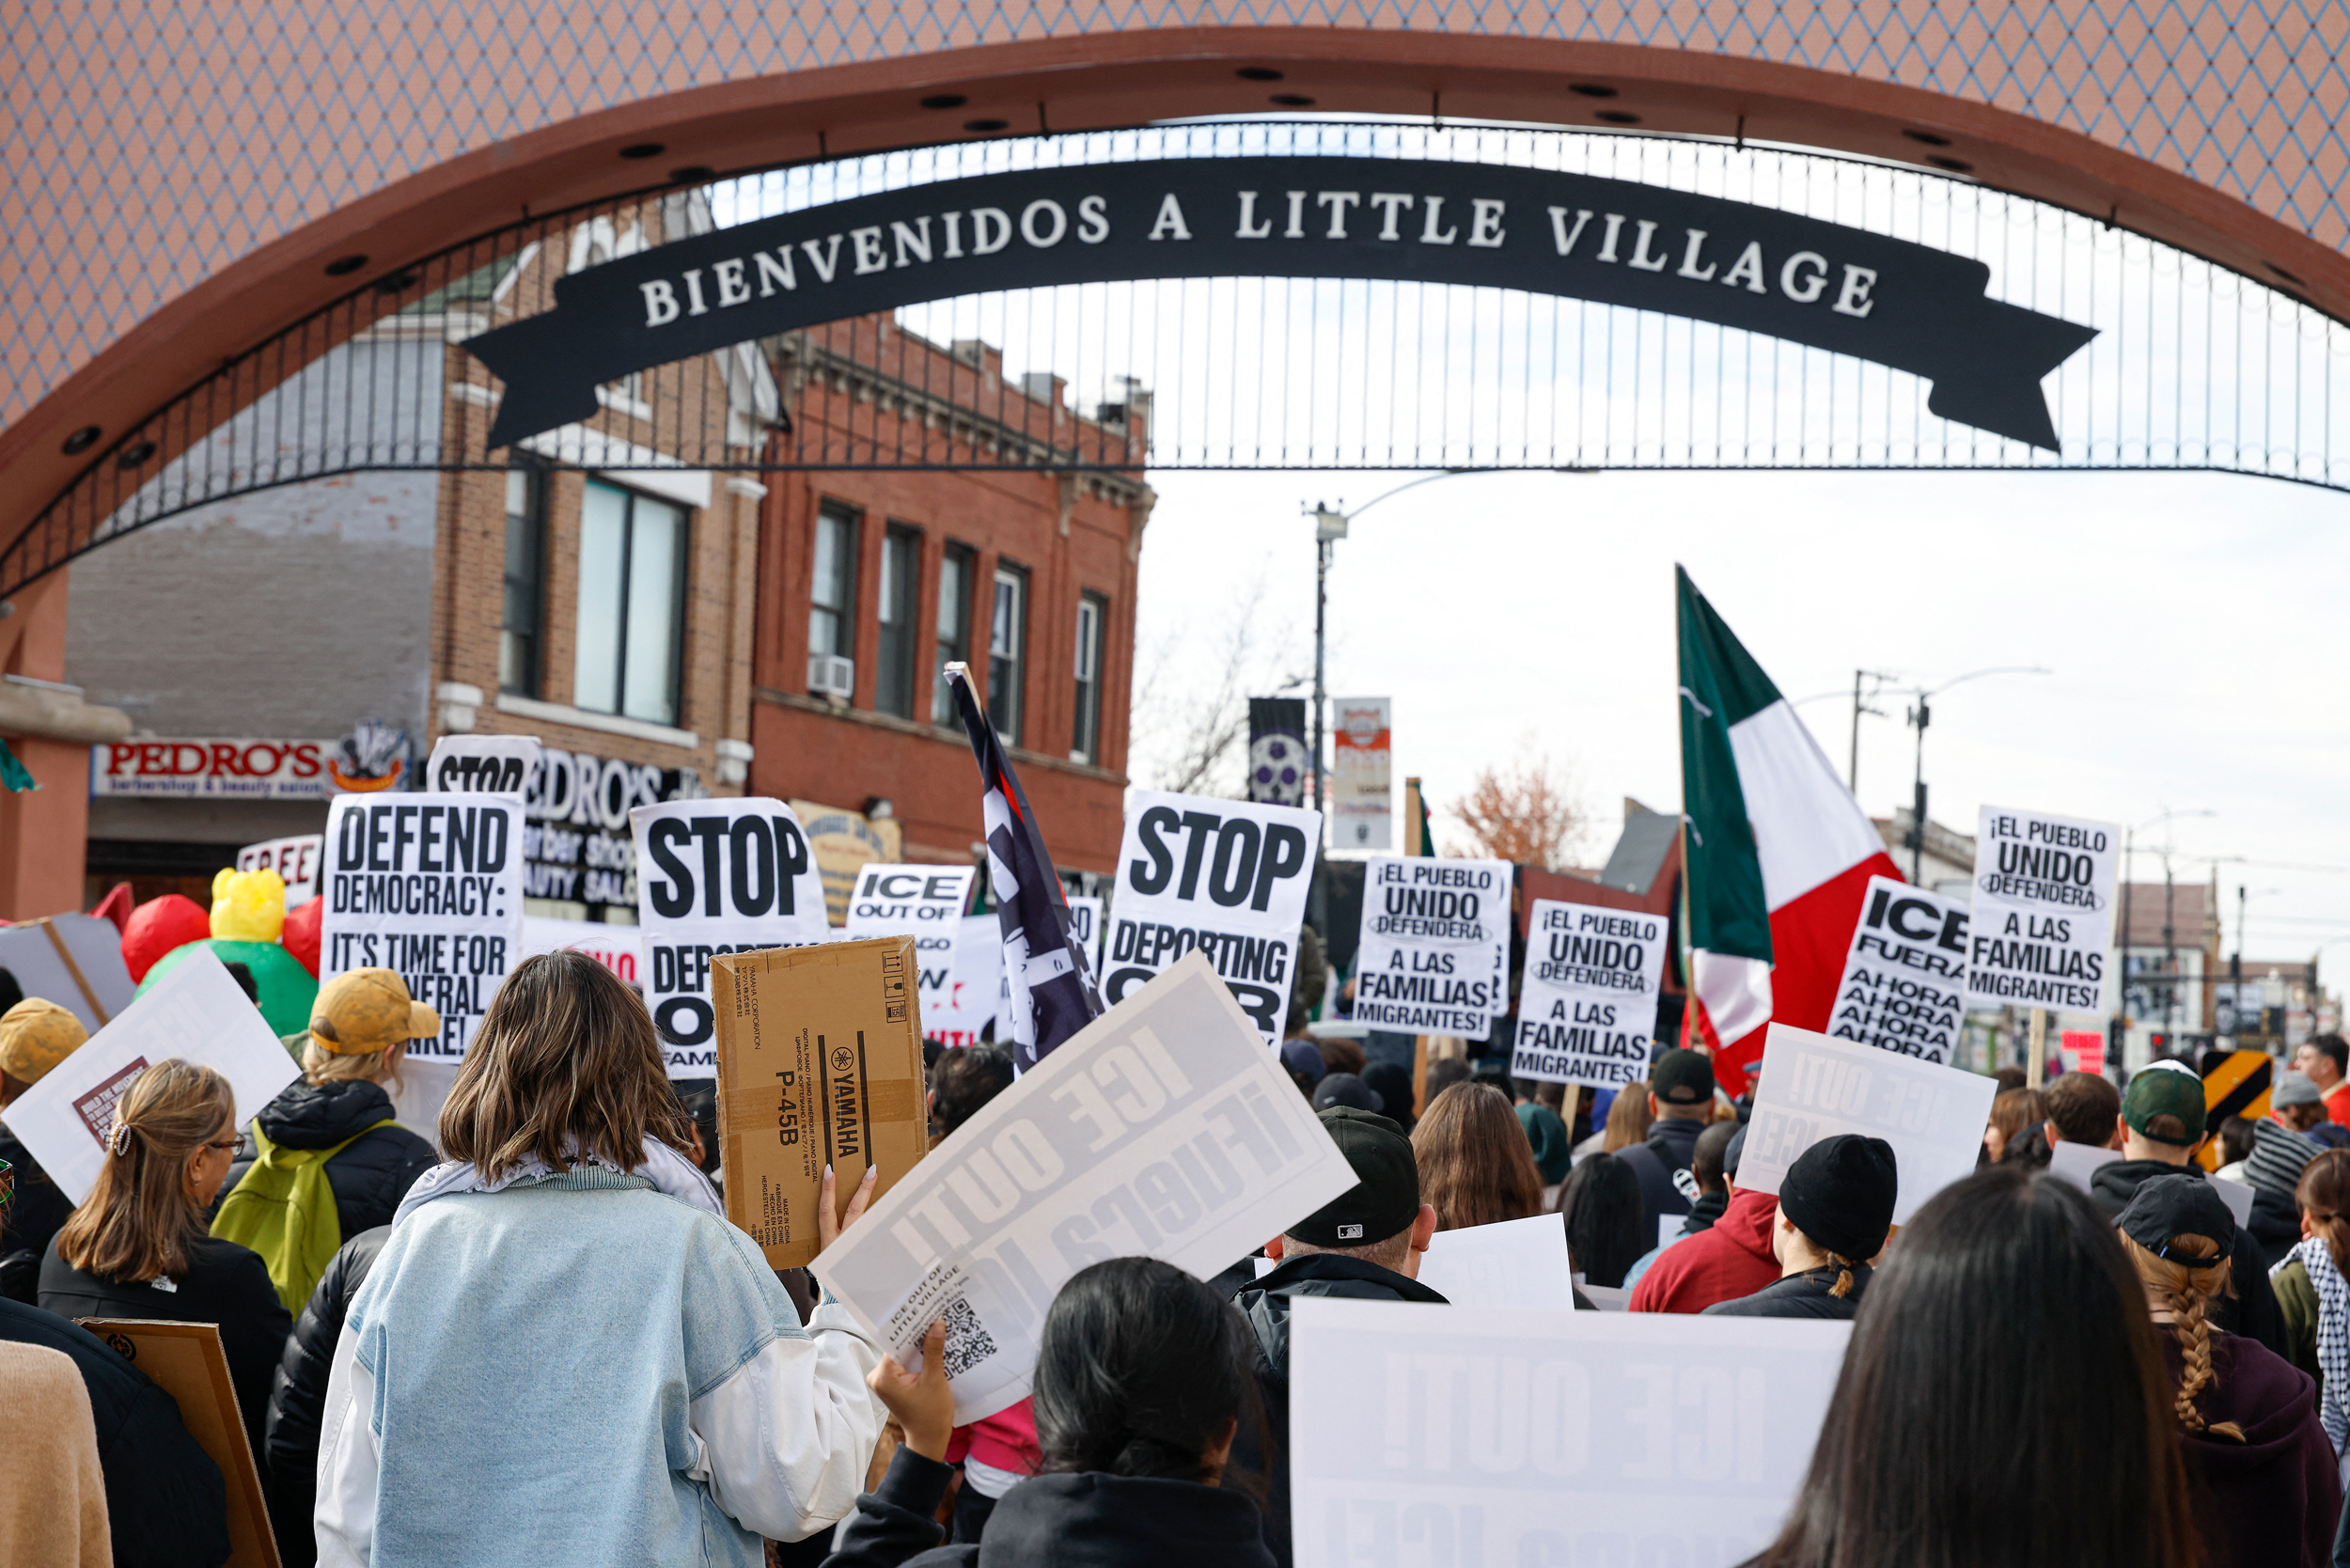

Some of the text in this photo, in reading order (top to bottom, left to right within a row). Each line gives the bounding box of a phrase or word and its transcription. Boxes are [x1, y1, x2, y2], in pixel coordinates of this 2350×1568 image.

[639, 191, 1878, 327] BIENVENIDOS A LITTLE VILLAGE
[106, 743, 321, 777] PEDRO'S
[110, 777, 196, 795] barbershop
[203, 777, 214, 792] &
[219, 778, 273, 796] beauty
[525, 747, 662, 830] EDRO'S
[338, 806, 508, 873] DEFEND
[1991, 816, 2106, 853] ¡EL PUEBLO
[648, 815, 807, 918] STOP
[1130, 806, 1307, 912] STOP
[1378, 865, 1492, 889] ¡EL PUEBLO
[1998, 841, 2093, 886] UNIDO
[333, 874, 506, 917] DEMOCRACY:
[583, 870, 637, 905] SALO
[862, 873, 963, 900] ICE
[1385, 886, 1480, 921] UNIDO
[1989, 873, 2096, 910] DEFENDERÁ
[856, 903, 955, 920] OUT OF
[1377, 916, 1482, 941] DEFENDERÁ
[1543, 910, 1657, 941] ¡EL PUEBLO
[1866, 888, 1969, 953] ICE
[2004, 912, 2071, 943] A LAS
[331, 933, 506, 975] IT'S TIME FOR
[1112, 919, 1288, 985] DEPORTING
[1389, 949, 1455, 974] A LAS
[1549, 933, 1644, 972] UNIDO
[1857, 934, 1966, 979] FUERA
[1971, 936, 2103, 981] FAMILIAS
[402, 975, 486, 1015] NERAL
[1359, 973, 1488, 1008] FAMILIAS
[1540, 962, 1645, 993] DEFENDERÁ
[1850, 968, 1962, 1012] AHORA
[1969, 971, 2098, 1009] MIGRANTES!
[749, 964, 761, 1050] YAMAHA CORPORATION
[1356, 1003, 1483, 1032] MIGRANTES!
[1550, 999, 1617, 1027] A LAS
[1844, 987, 1956, 1031] AHORA
[1519, 1022, 1646, 1060] FAMILIAS
[1834, 1025, 1942, 1065] AHORA
[1840, 1006, 1950, 1050] AHORA
[1515, 1052, 1642, 1083] MIGRANTES!
[99, 1088, 115, 1102] THE
[776, 1070, 799, 1147] P-45B
[802, 1028, 810, 1053] DIGITAL
[810, 1160, 819, 1184] DIGITAL
[834, 1073, 858, 1158] YAMAHA
[761, 1175, 770, 1218] HERGESTELLT
[771, 1216, 776, 1226] EN
[777, 1215, 784, 1225] EN
[889, 1308, 919, 1342] LITTLE
[918, 1265, 961, 1307] VILLAGE
[891, 1265, 943, 1325] ICE OUT OF
